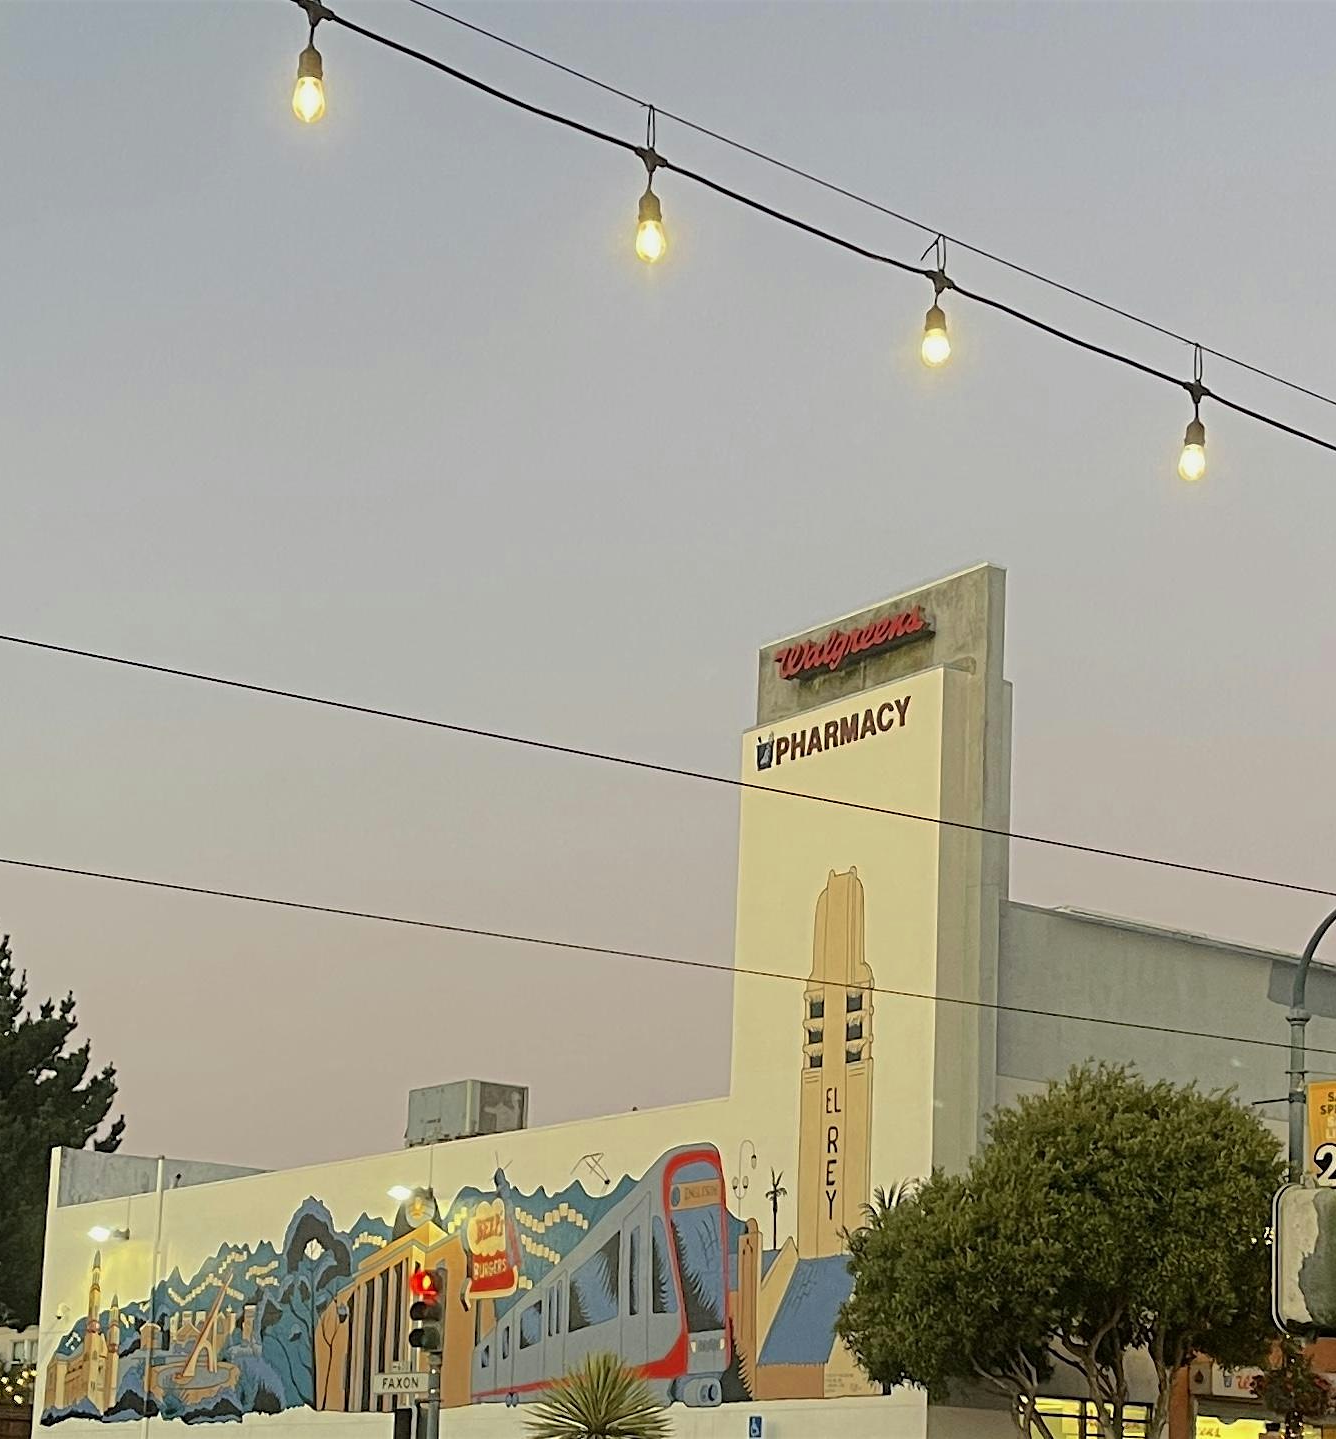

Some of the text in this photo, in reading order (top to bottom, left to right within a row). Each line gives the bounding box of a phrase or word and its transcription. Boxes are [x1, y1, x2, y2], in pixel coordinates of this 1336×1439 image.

[775, 605, 926, 679] Walgreens
[776, 696, 911, 765] PHARMACY
[825, 1087, 841, 1220] EL REY
[473, 1258, 507, 1280] BURGERS
[382, 1377, 419, 1389] FAXON
